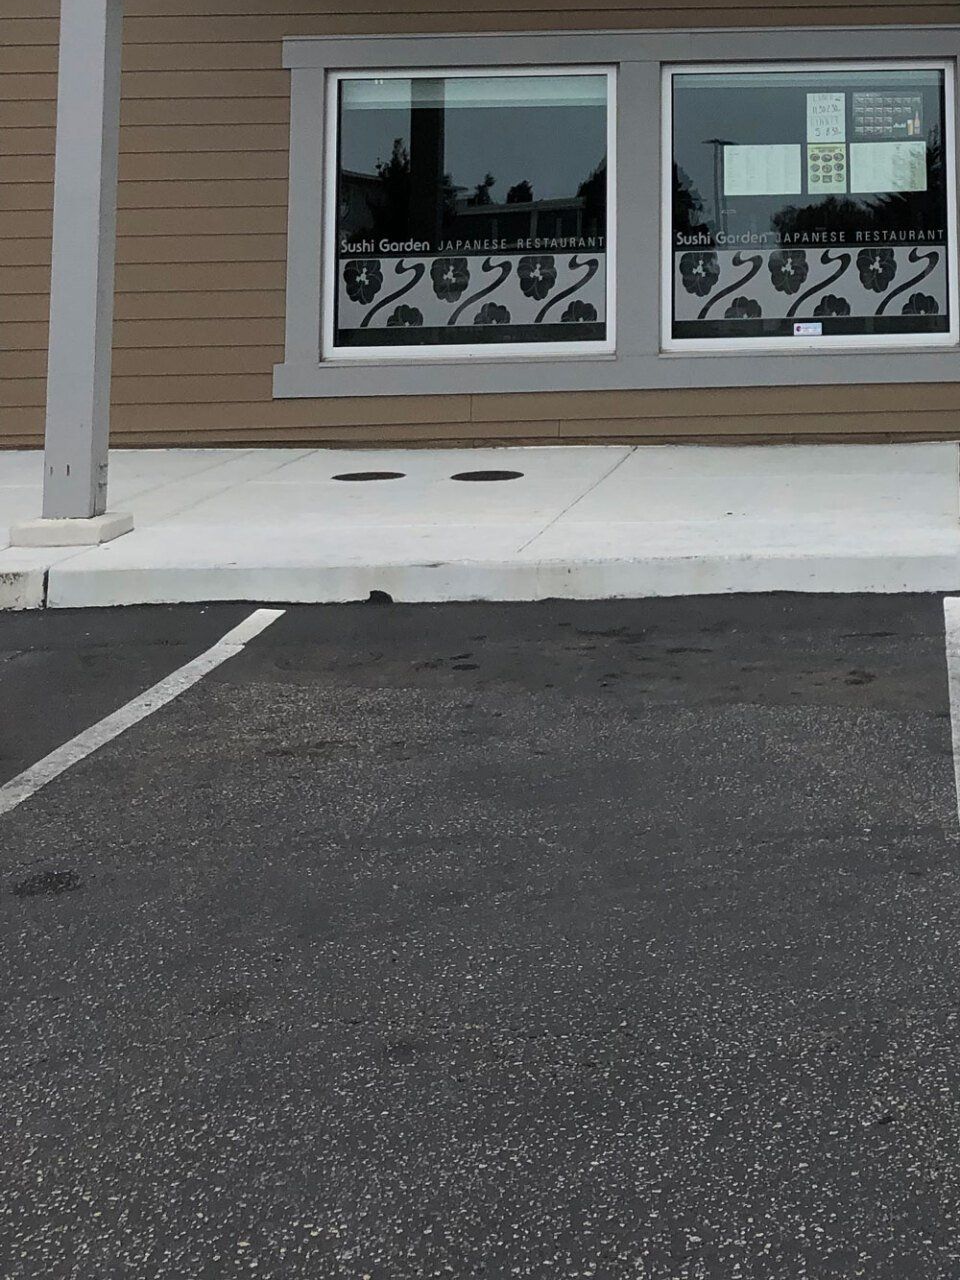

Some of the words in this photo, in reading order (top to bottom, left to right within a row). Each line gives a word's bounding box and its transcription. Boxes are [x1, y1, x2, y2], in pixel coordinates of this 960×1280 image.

[340, 239, 375, 253] Sushi
[379, 238, 430, 252] Garden
[437, 238, 507, 251] JAPANESE
[517, 236, 605, 249] RESTAURANT
[676, 232, 711, 245] Sushi
[716, 231, 767, 244] Garden
[775, 231, 846, 243] JAPANESE
[856, 229, 944, 242] RESTAURANT
